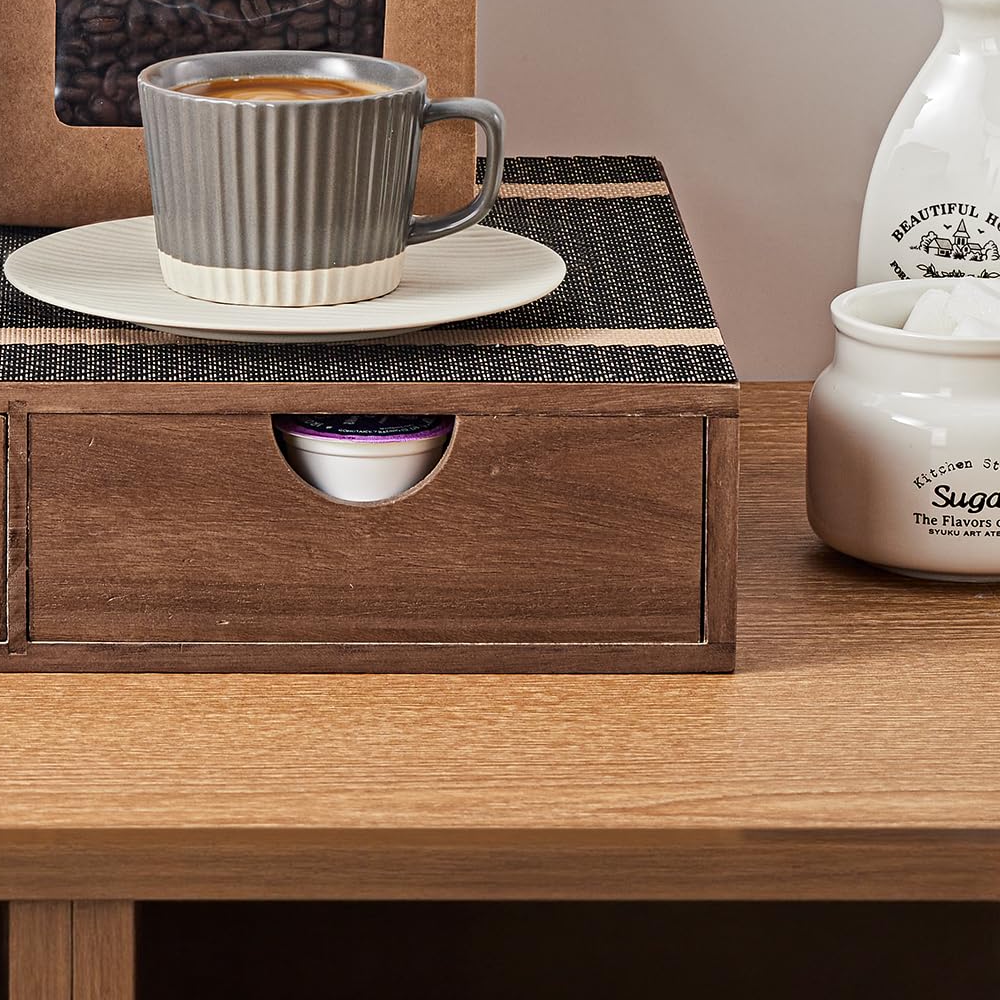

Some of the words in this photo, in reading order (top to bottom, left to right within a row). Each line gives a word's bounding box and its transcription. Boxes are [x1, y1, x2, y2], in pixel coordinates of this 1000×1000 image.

[891, 203, 979, 242] BEAUTIFUL
[985, 212, 1000, 232] H
[913, 460, 973, 489] Kitchen
[913, 512, 938, 526] The
[942, 515, 991, 528] Flavors
[928, 528, 960, 536] SYUKU
